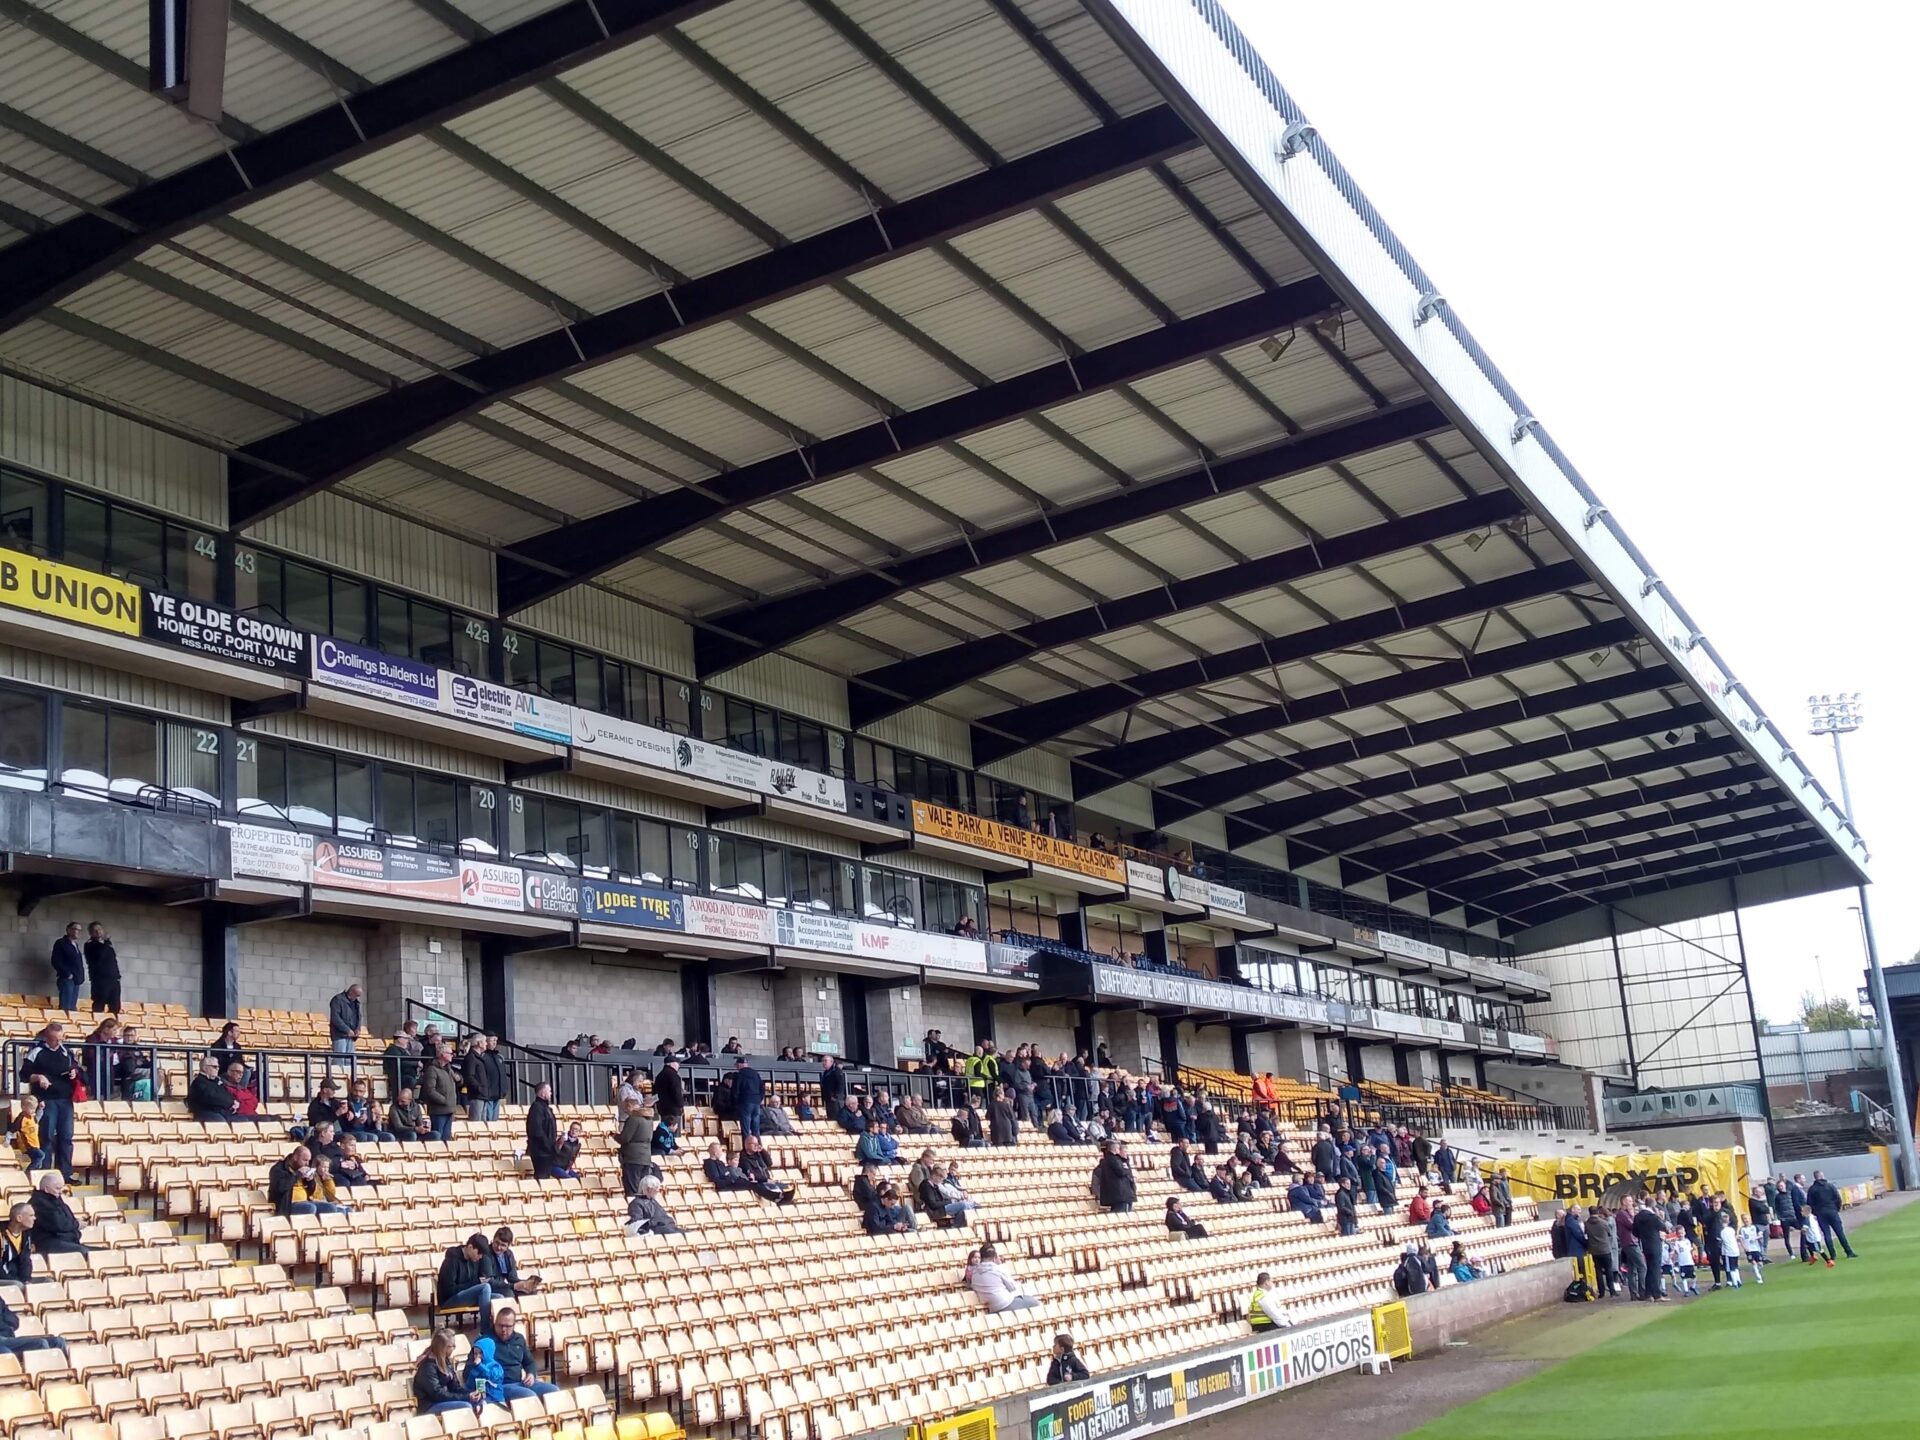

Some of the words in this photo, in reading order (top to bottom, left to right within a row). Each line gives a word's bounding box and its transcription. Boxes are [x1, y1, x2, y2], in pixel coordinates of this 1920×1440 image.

[194, 536, 216, 560] 44
[235, 551, 256, 574] 43
[32, 569, 136, 623] UNION
[149, 592, 175, 616] YE
[181, 602, 232, 632] OLDE
[236, 617, 303, 650] CROWN
[157, 616, 199, 639] HOME
[203, 629, 222, 644] OF
[225, 634, 261, 654] PORT
[263, 644, 296, 663] VALE
[465, 621, 490, 644] 42a
[502, 634, 519, 655] 42
[257, 657, 275, 667] LTD
[379, 661, 418, 684] Builders
[420, 672, 436, 689] Ltd
[479, 685, 512, 707] electric
[515, 693, 540, 716] AML
[679, 686, 690, 702] 41
[700, 695, 712, 711] 40
[196, 731, 218, 754] 22
[236, 740, 256, 763] 21
[597, 729, 634, 744] CERAMIC
[636, 739, 671, 754] DESIGNS
[479, 790, 495, 809] 20
[508, 794, 523, 813] 19
[801, 791, 812, 801] Pride
[815, 795, 830, 806] Passion
[833, 799, 845, 809] Belief
[231, 826, 291, 846] PROPERTIES
[293, 835, 313, 849] LTD
[687, 833, 699, 850] 18
[708, 837, 720, 854] 17
[927, 805, 952, 828] VALE
[957, 814, 981, 835] PARK
[987, 823, 994, 837] A
[997, 825, 1026, 847] VENUE
[1031, 835, 1049, 852] FOR
[1053, 841, 1069, 858] ALL
[1072, 846, 1115, 870] OCCASIONS
[258, 844, 284, 854] ALSAGER
[285, 848, 299, 857] AREA
[338, 845, 383, 862] ASSURED
[999, 842, 1007, 851] TO
[1008, 844, 1021, 855] VIEW
[1023, 849, 1034, 858] OUR
[1036, 852, 1055, 864] SUPERB
[1057, 857, 1082, 871] CATERING
[339, 867, 360, 877] STAFFS
[361, 870, 383, 878] LIMITED
[483, 868, 520, 885] ASSURED
[844, 864, 855, 879] 16
[542, 878, 579, 903] Caldan
[970, 890, 979, 903] 14
[543, 899, 579, 914] ELECTRICAL
[596, 890, 637, 910] LODGE
[640, 896, 671, 920] TYRE
[721, 904, 736, 916] AND
[737, 906, 769, 921] COMPANY
[704, 924, 721, 934] PHONE
[798, 926, 832, 938] Accountants
[834, 930, 853, 941] Limited
[799, 915, 822, 927] General
[824, 920, 829, 928] &
[829, 921, 850, 931] Medical
[861, 932, 890, 949] KMF
[1100, 969, 1153, 998] STAFFORDSHIRE
[1152, 978, 1188, 1003] UNIVERSITY
[1188, 983, 1196, 1004] IN
[1196, 984, 1233, 1009] PARTNERSHIP
[1233, 990, 1248, 1011] WITH
[1290, 1328, 1336, 1353] MADELEY
[1340, 1320, 1368, 1339] HEATH
[1292, 1334, 1371, 1380] MOTORS
[1152, 1384, 1186, 1410] FOOTBALL
[1186, 1379, 1199, 1400] HAS
[1198, 1377, 1207, 1396] NO
[1207, 1371, 1231, 1394] GENDER
[1068, 1392, 1112, 1423] FOOTBALL
[1110, 1384, 1128, 1406] HAS
[1069, 1422, 1087, 1440] NO
[1087, 1404, 1130, 1440] GENDER
